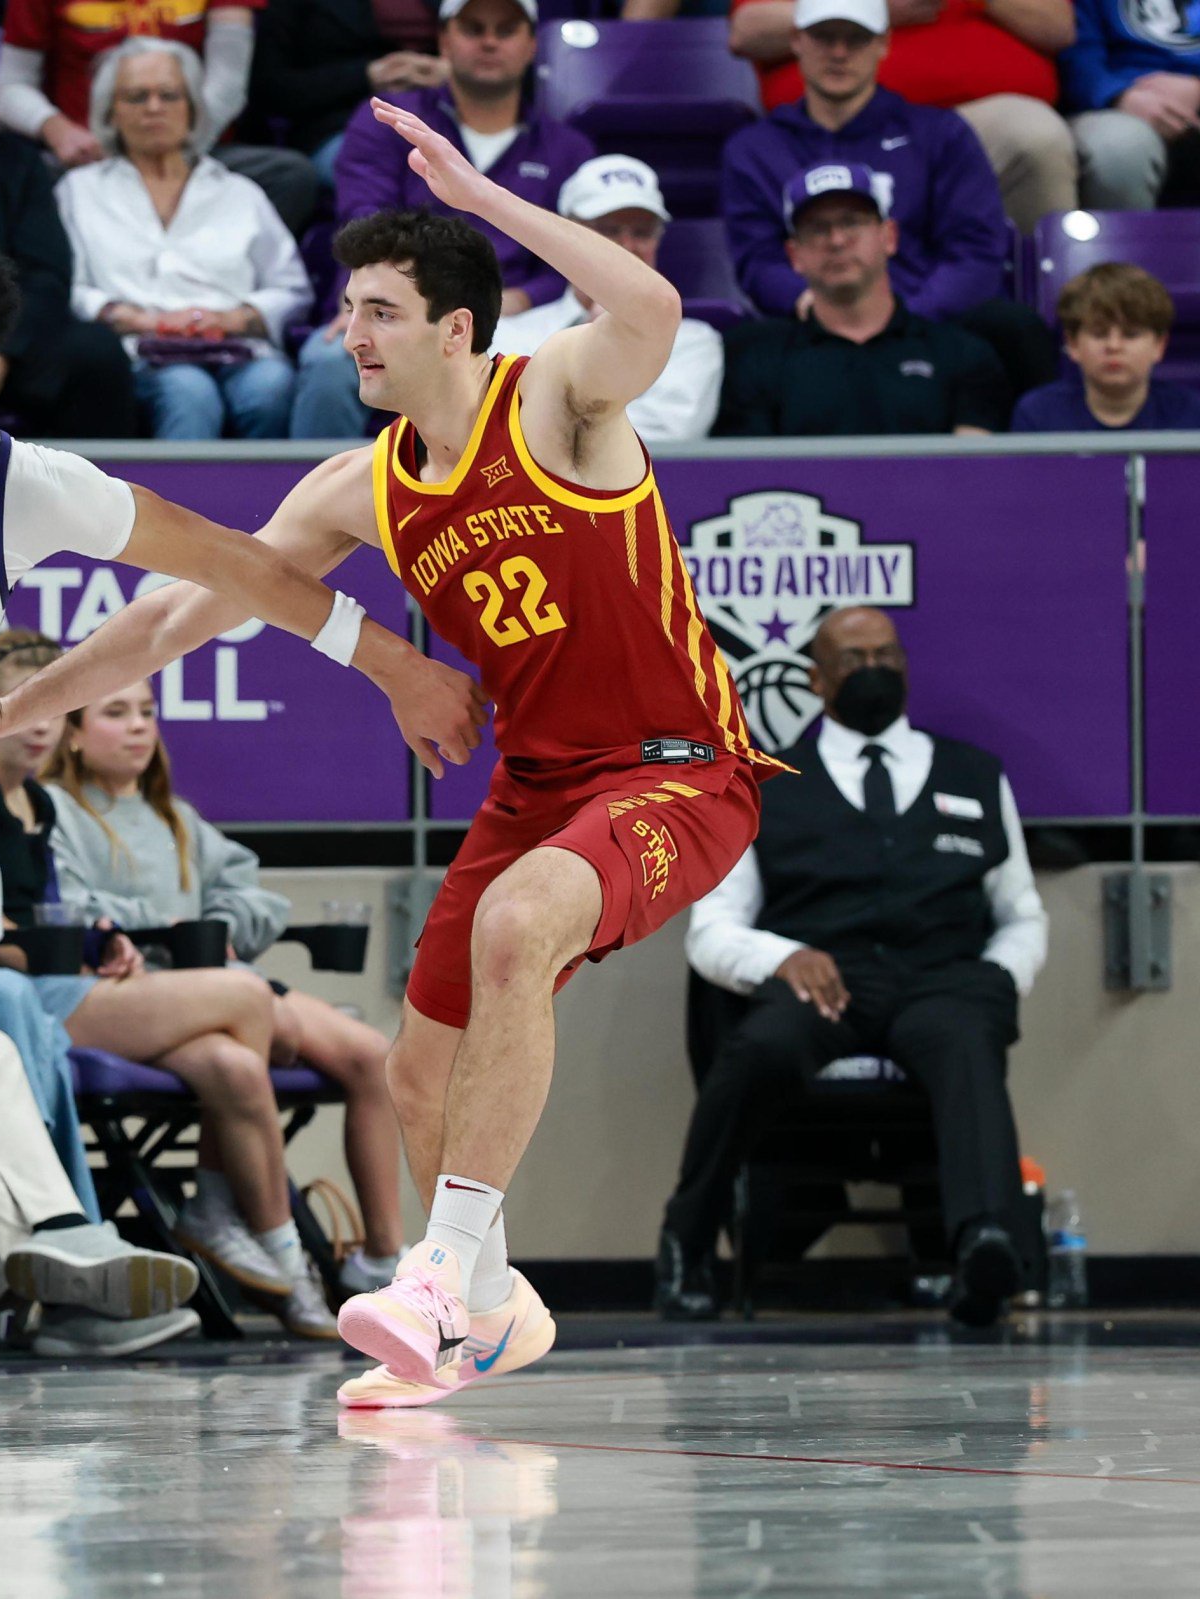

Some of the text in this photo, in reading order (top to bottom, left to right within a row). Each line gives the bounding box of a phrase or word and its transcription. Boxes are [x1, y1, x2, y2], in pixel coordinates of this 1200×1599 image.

[410, 504, 565, 597] IOWA STATE
[773, 554, 899, 597] ARMY
[462, 555, 567, 648] 22
[631, 819, 670, 901] STATE
